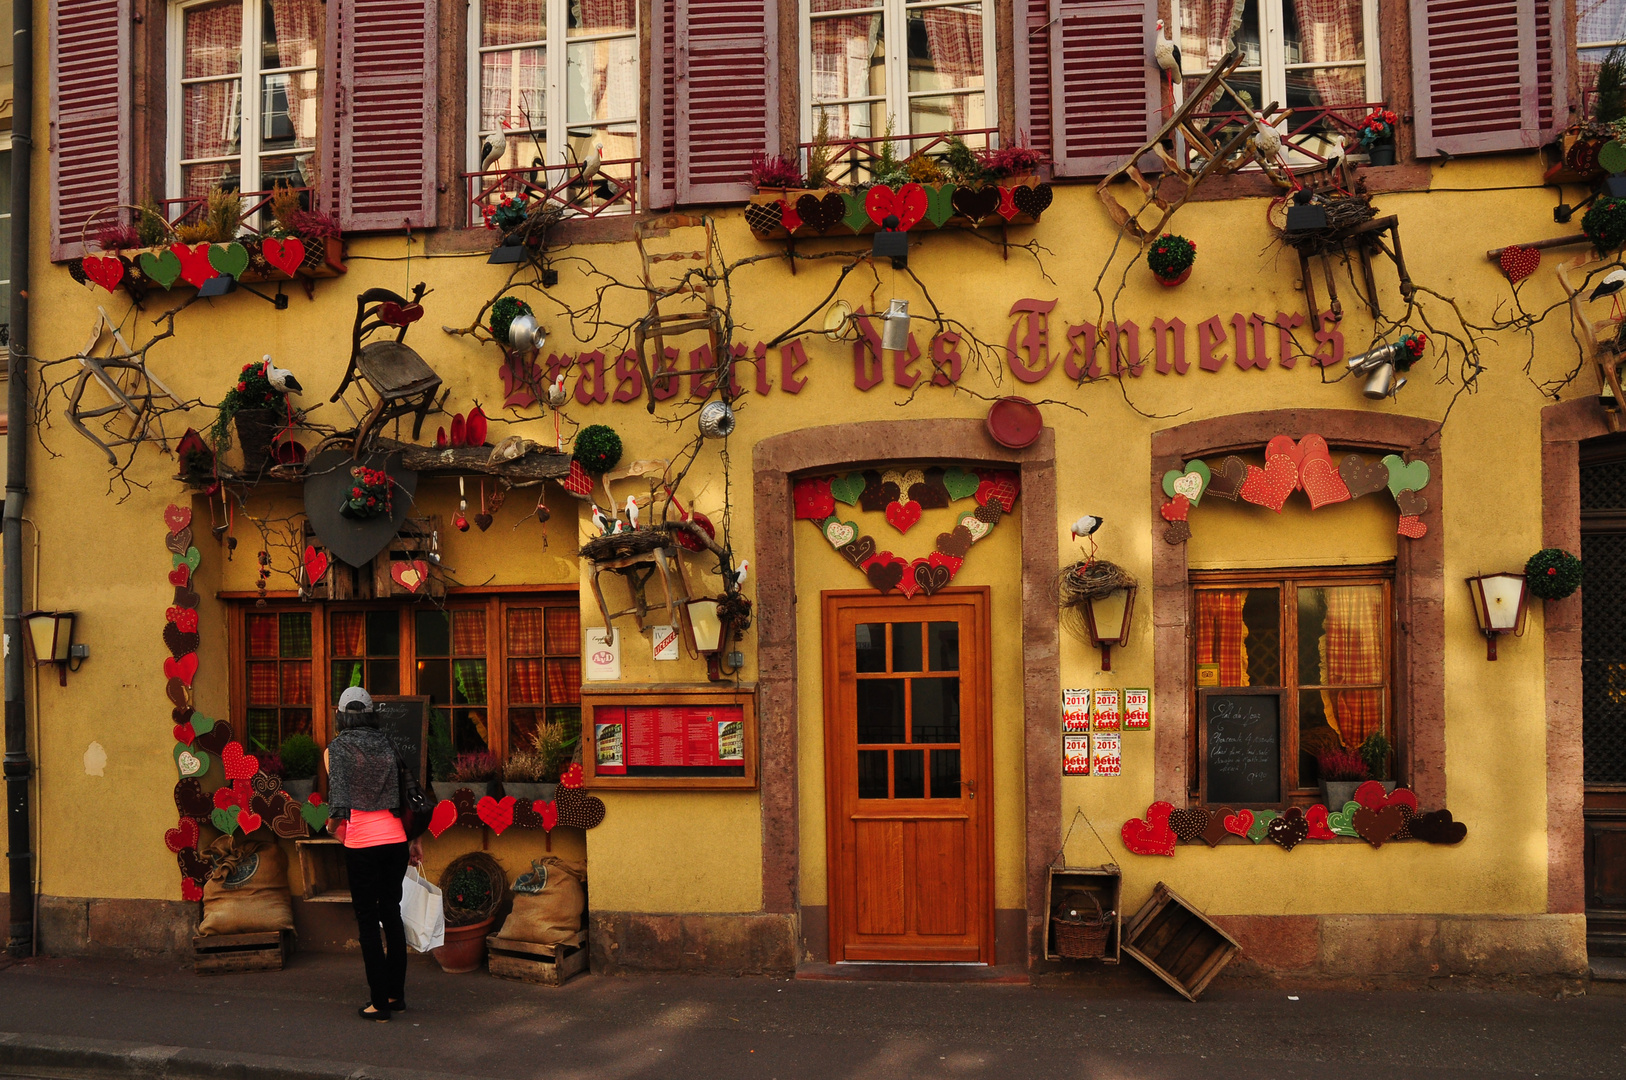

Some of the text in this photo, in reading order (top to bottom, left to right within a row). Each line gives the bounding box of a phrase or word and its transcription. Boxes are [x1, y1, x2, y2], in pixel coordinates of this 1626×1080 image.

[499, 297, 1344, 410] Brasserie des Tanneurs
[1066, 697, 1085, 705] 2011
[1097, 697, 1116, 705] 2012
[1127, 696, 1147, 704] 2013
[1063, 712, 1089, 722] petit
[1094, 711, 1120, 721] petit
[1124, 711, 1149, 721] petit
[1067, 720, 1089, 729] futé
[1098, 720, 1120, 728] futé
[1128, 719, 1149, 728] futé
[1066, 742, 1086, 750] 2014
[1097, 742, 1117, 750] 2015
[1063, 757, 1089, 767] petit
[1094, 757, 1119, 767] petit
[1067, 765, 1089, 773] futé
[1098, 765, 1119, 773] futé
